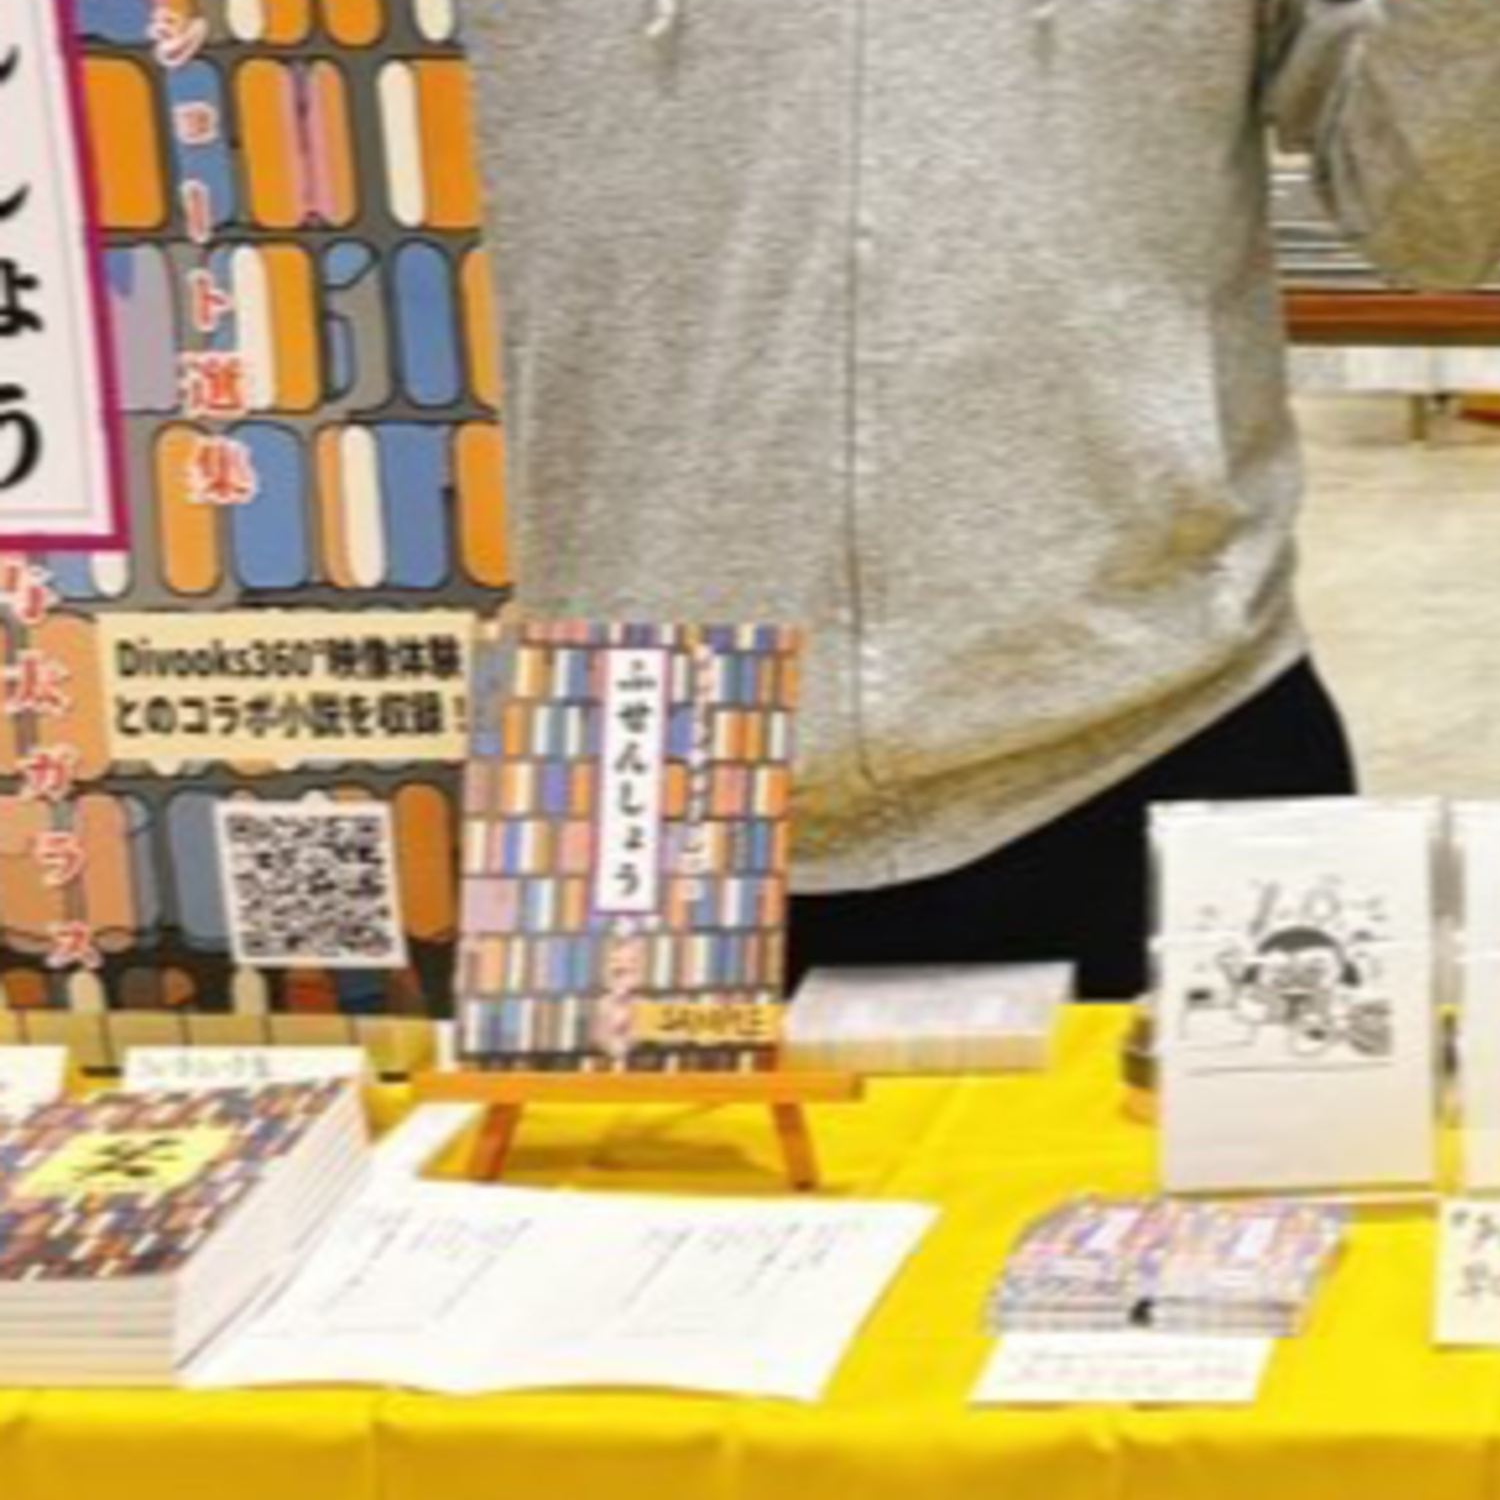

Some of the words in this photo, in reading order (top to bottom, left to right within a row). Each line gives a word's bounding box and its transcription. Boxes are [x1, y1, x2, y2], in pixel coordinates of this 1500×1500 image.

[613, 659, 658, 898] ふせんしょう
